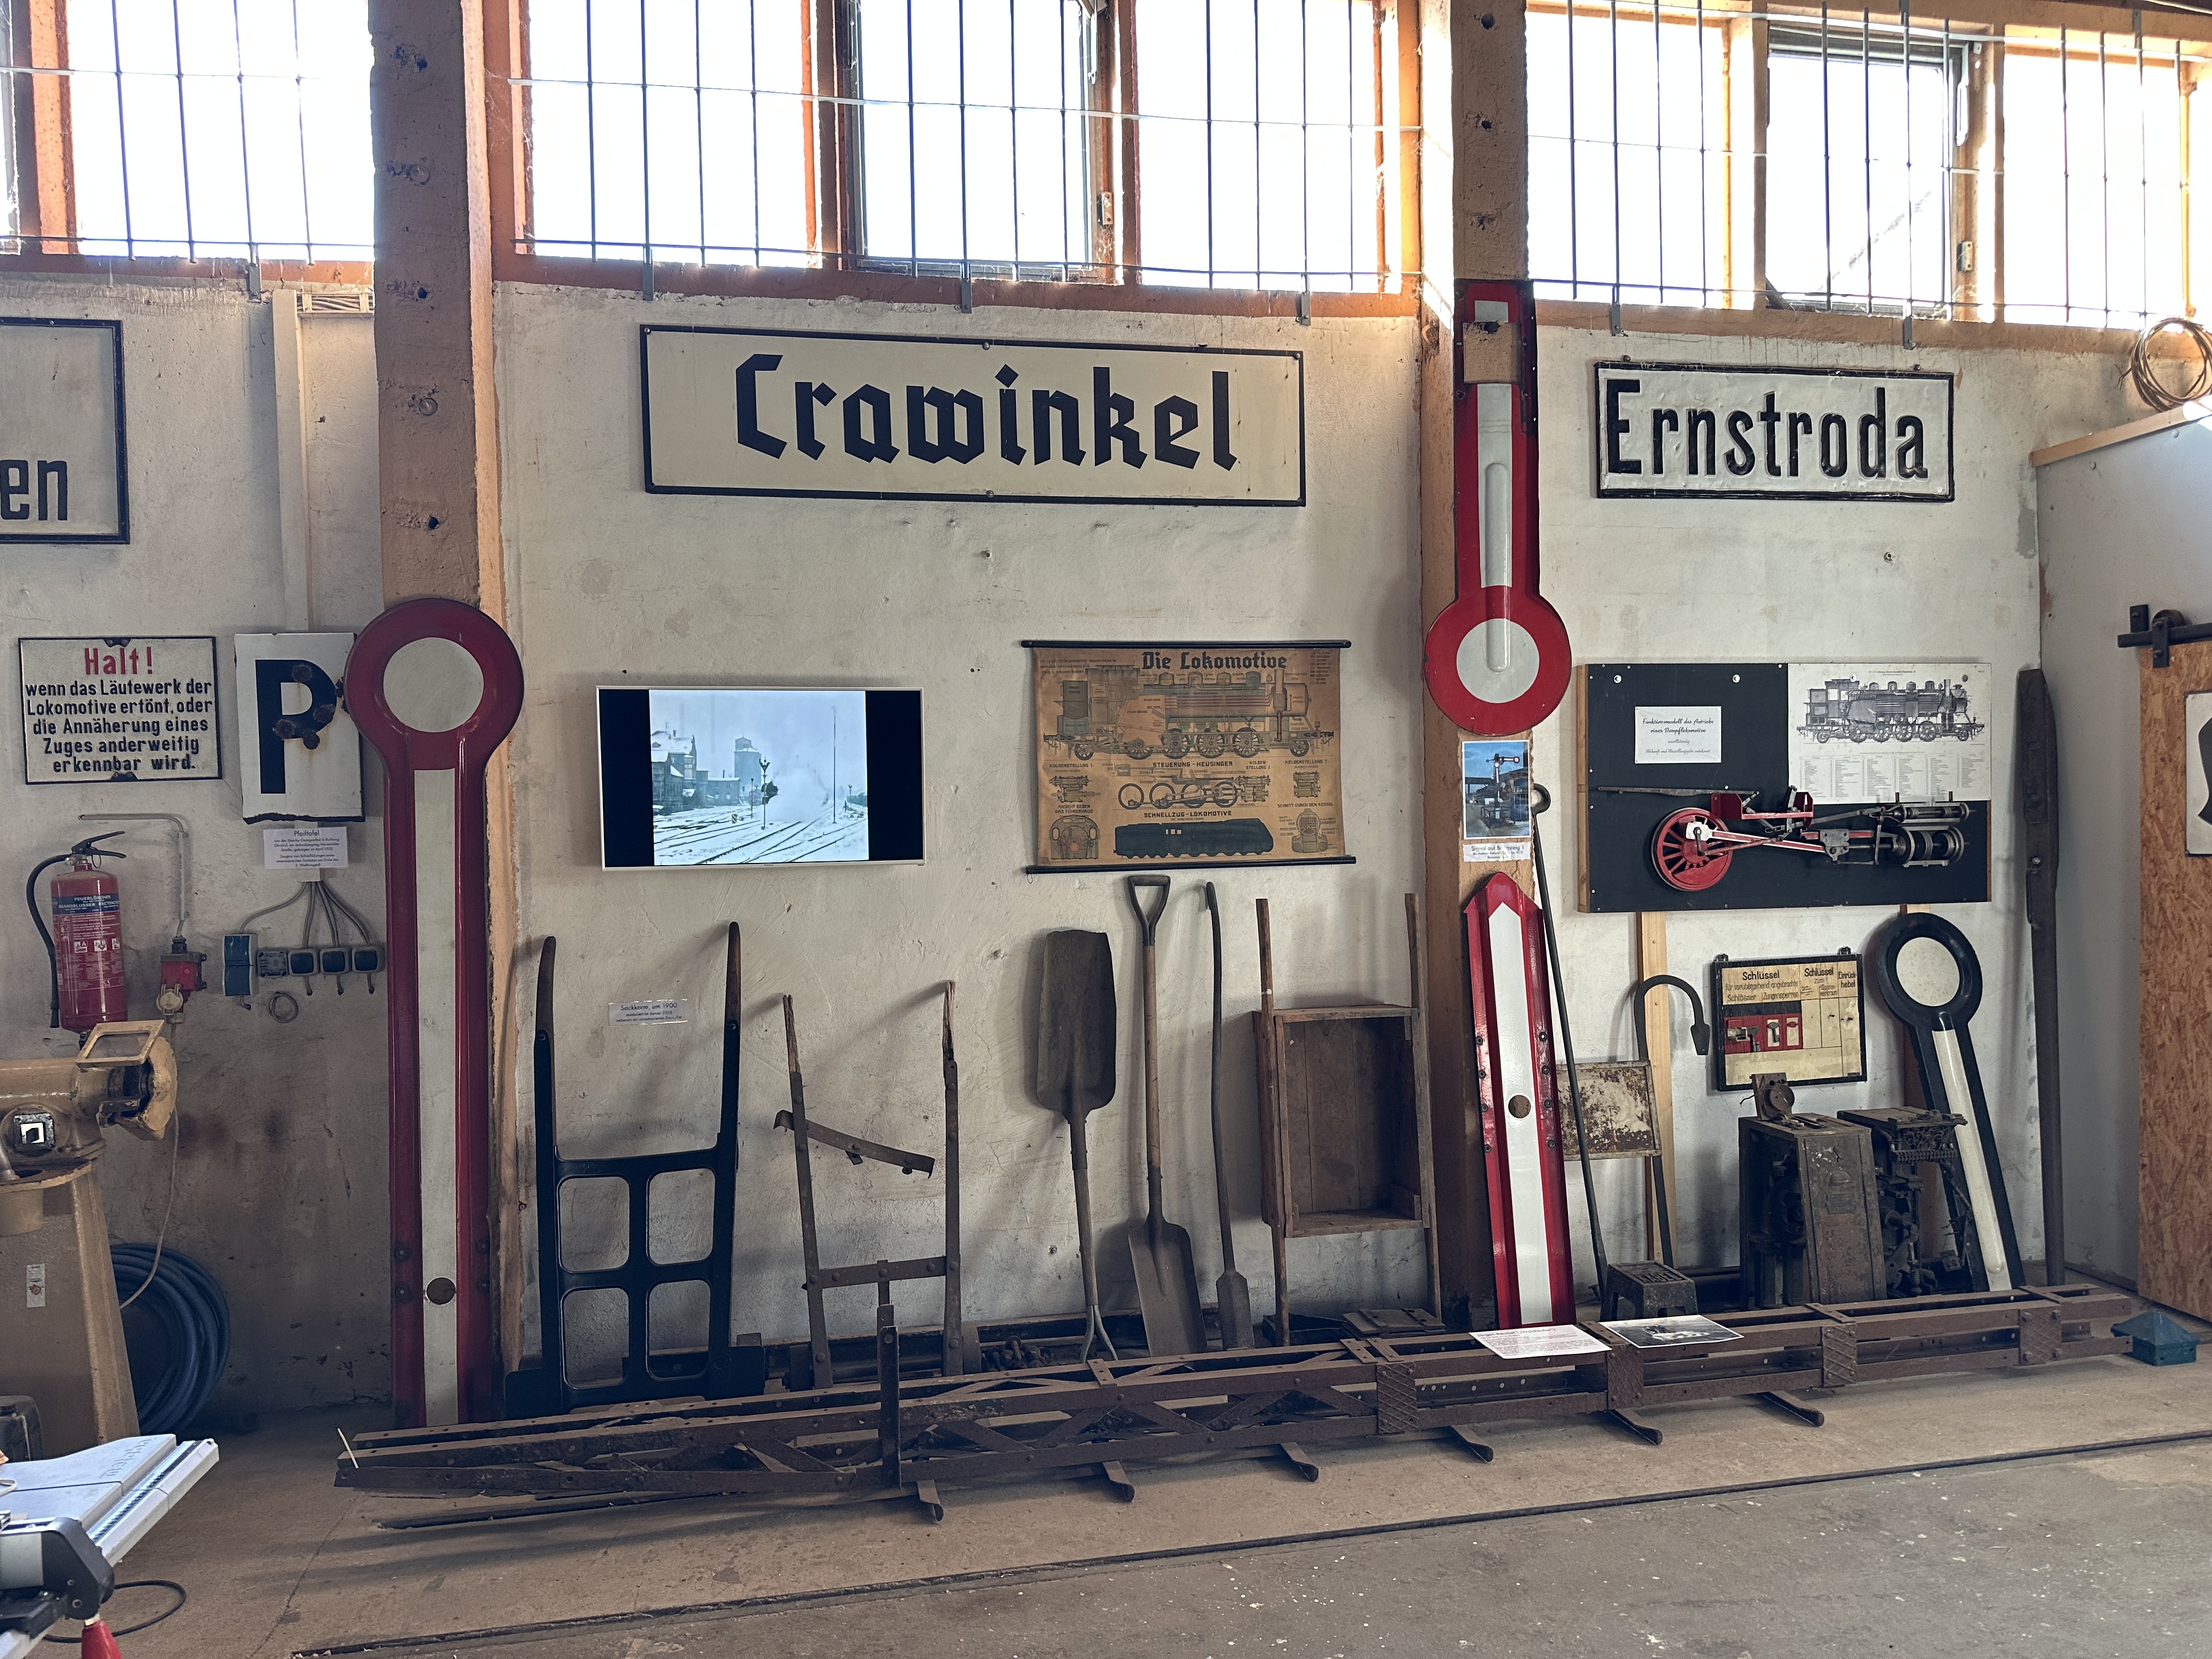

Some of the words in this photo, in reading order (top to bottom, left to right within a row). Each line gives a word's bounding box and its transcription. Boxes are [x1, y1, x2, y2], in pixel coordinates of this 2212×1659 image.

[736, 353, 1238, 471] Crawinkel
[1606, 379, 1928, 479] Ernstroda
[0, 459, 67, 521] en
[84, 646, 154, 675] Halt!
[1142, 651, 1171, 669] Die
[1180, 651, 1287, 669] Lokomotive
[25, 684, 66, 697] wenn
[70, 680, 97, 696] das
[100, 678, 182, 696] Läutewerk
[187, 679, 212, 695] der
[27, 699, 117, 716] Lokomotive
[177, 699, 213, 713] oder
[33, 719, 57, 735] die
[63, 718, 161, 737] Annäherung
[166, 718, 208, 732] eines
[255, 660, 337, 794] P
[44, 738, 93, 757] Zuges
[53, 757, 141, 773] erkennbar
[151, 755, 196, 772] wird.
[1742, 969, 1780, 980] Schlüssel
[1804, 967, 1833, 977] Schlüssel
[1841, 980, 1855, 988] hebel
